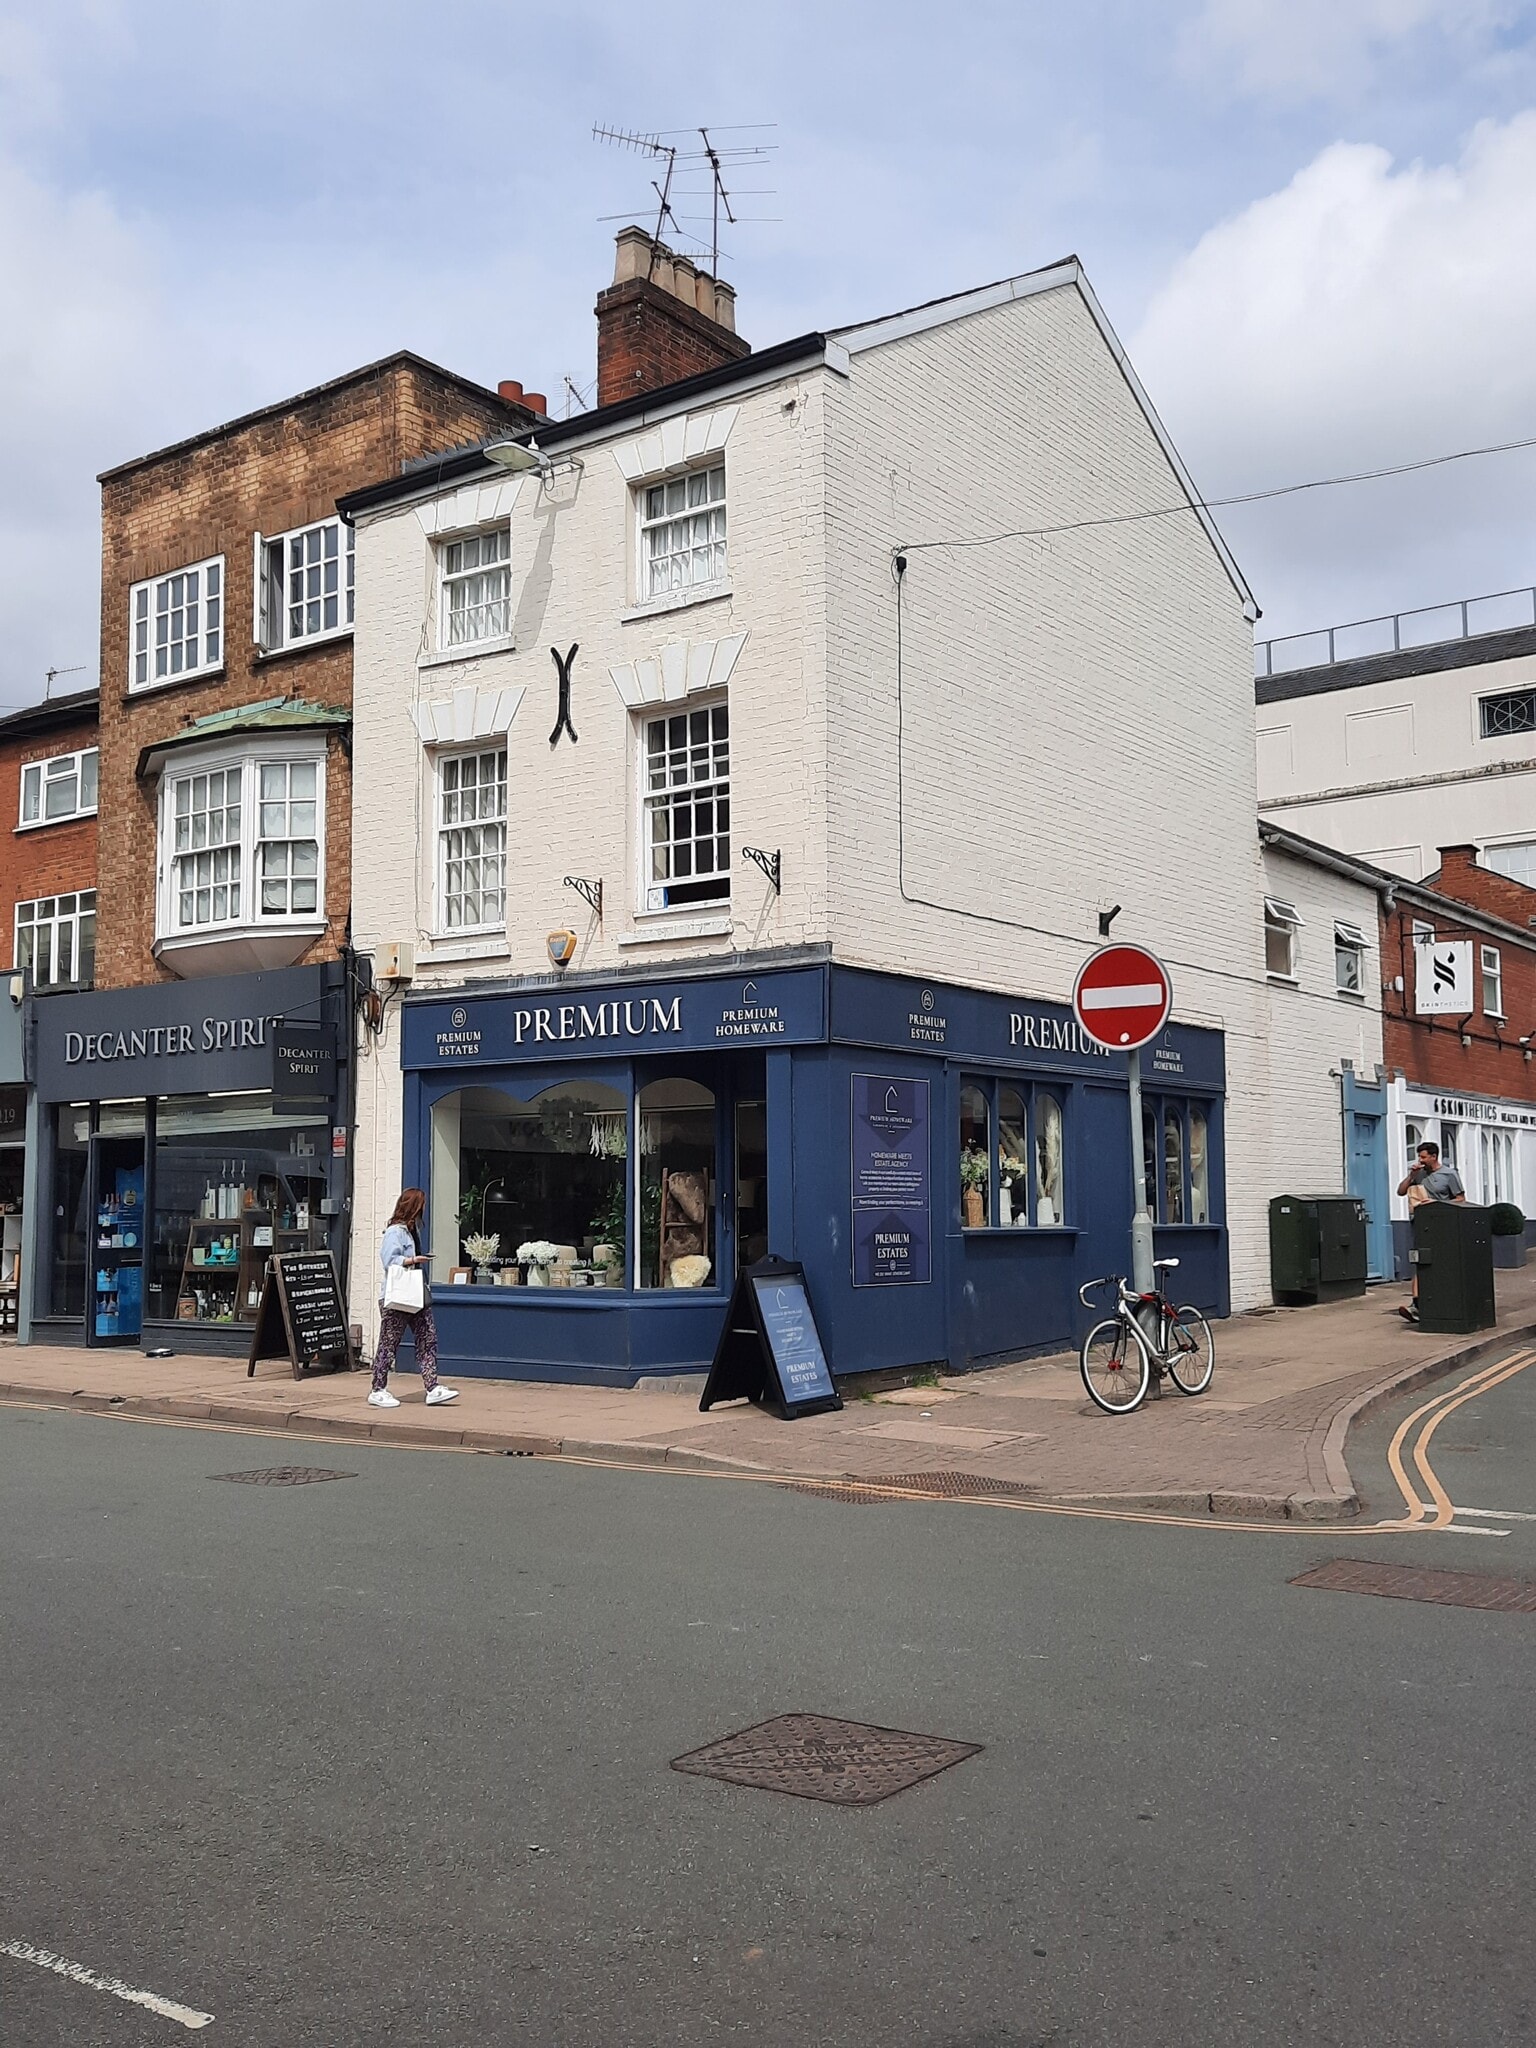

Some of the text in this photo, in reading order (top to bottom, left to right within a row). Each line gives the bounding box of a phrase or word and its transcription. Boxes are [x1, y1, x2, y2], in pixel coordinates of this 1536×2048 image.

[1421, 1000, 1469, 1008] SKINTHETICS
[513, 996, 683, 1044] PREMIUM
[722, 1006, 779, 1022] PREMIUM
[908, 1013, 947, 1029] PREMIUM
[715, 1021, 785, 1037] HOMEWARE
[910, 1027, 945, 1042] ESTATES
[436, 1030, 482, 1044] PREMIUM
[64, 1024, 195, 1064] DECANTER
[438, 1044, 480, 1056] ESTATES
[277, 1047, 332, 1060] DECANTER
[1155, 1049, 1182, 1062] PREMIUM
[289, 1062, 321, 1075] SPIRIT
[1152, 1060, 1184, 1073] HOMEWARE
[1440, 1098, 1498, 1121] SKINTHETICS
[875, 1233, 910, 1245] PREMIUM
[877, 1247, 909, 1259] ESTATES
[786, 1361, 816, 1374] PREMIUM
[790, 1371, 818, 1384] ESTATES
